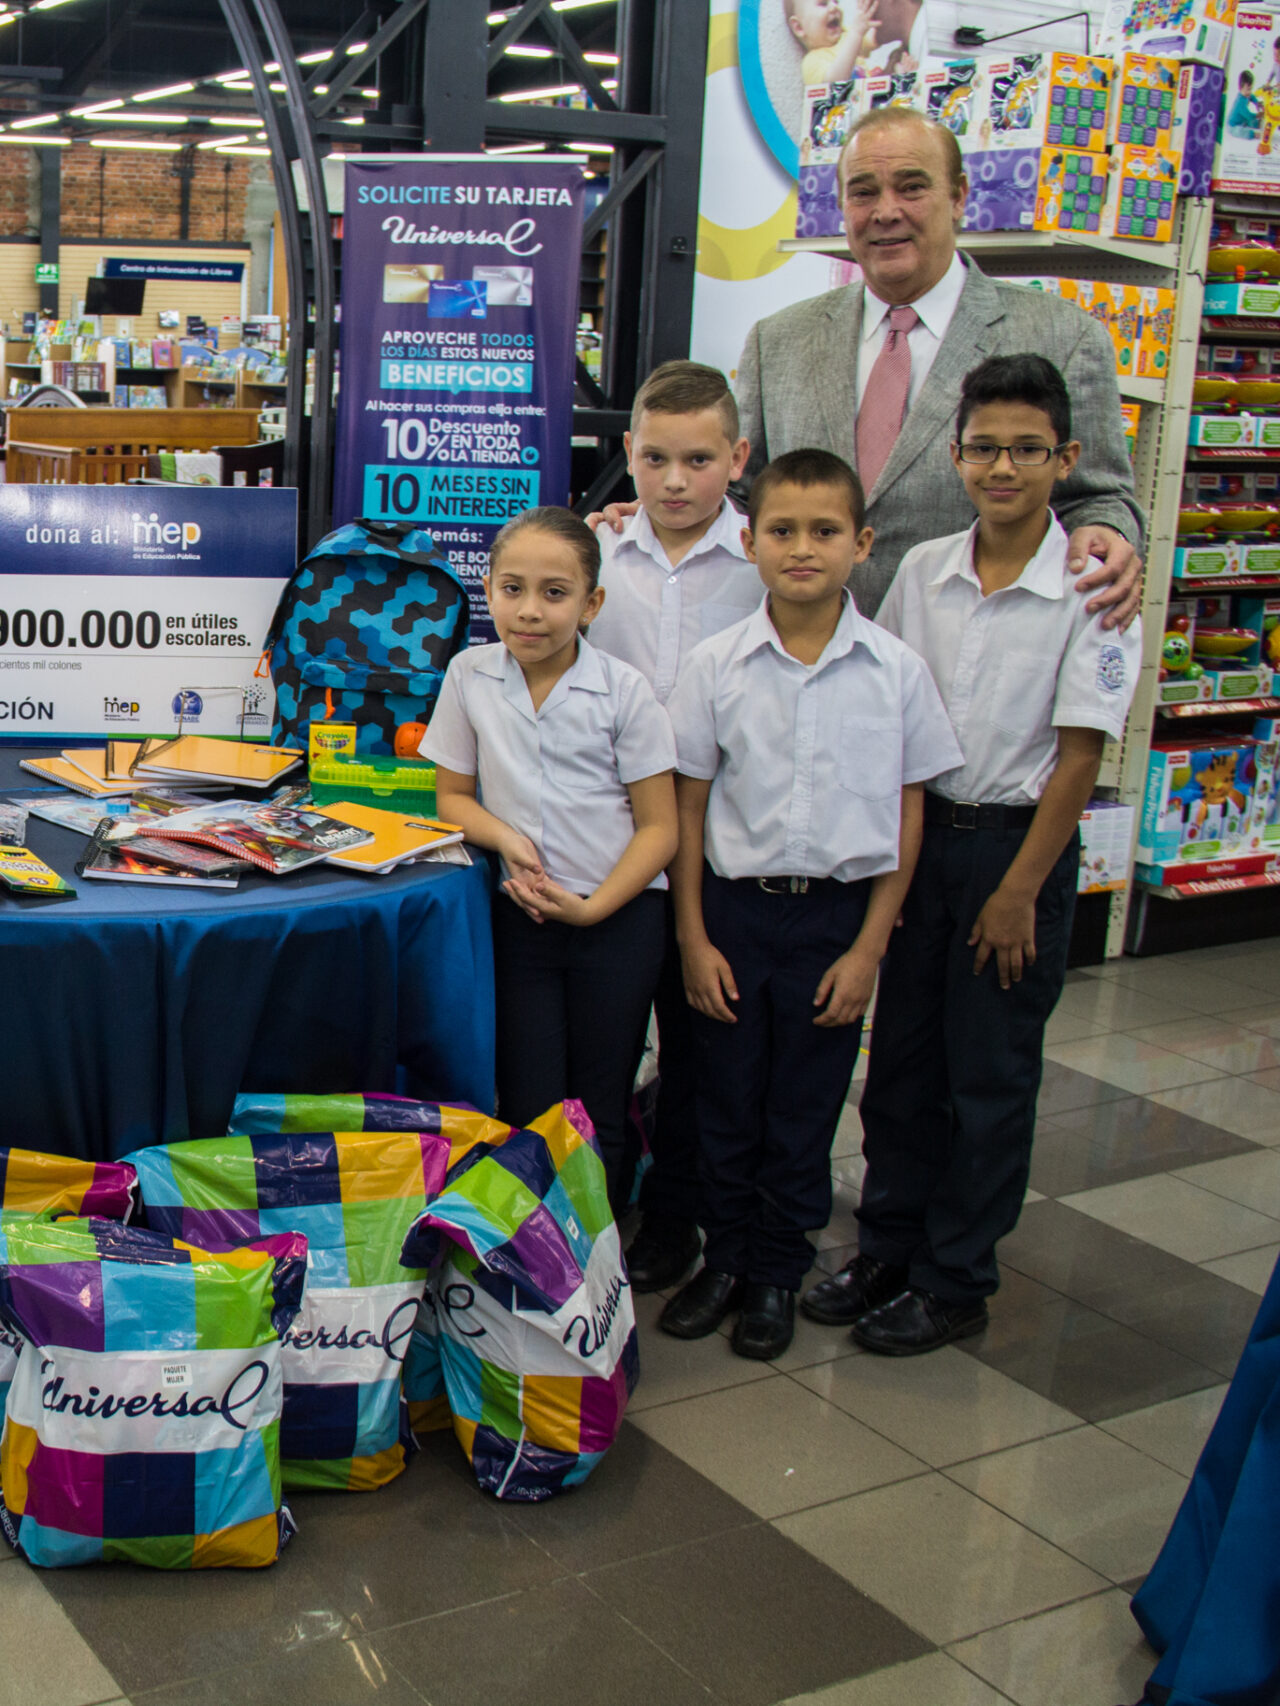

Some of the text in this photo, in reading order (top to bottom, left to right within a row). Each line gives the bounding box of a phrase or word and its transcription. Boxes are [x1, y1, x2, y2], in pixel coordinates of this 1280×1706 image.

[358, 185, 573, 206] SOLICITE SU TARJETA
[381, 215, 543, 256] Universal
[381, 330, 534, 347] APROVECHE TODOS
[380, 342, 535, 361] LOS DÍAS ESTOS NUEVOS
[387, 363, 525, 387] BENEFICIOS
[365, 400, 547, 417] Al hacer sus compras elija entre:
[429, 418, 521, 436] Descuento
[451, 435, 520, 450] EN TODA
[451, 450, 521, 464] LA TIENDA
[430, 474, 531, 495] MESES SIN
[374, 472, 420, 515] 10
[428, 496, 529, 518] INTERESES
[26, 523, 81, 544] dona
[91, 524, 119, 544] al:
[132, 512, 201, 551] mep
[425, 527, 484, 544] demás:
[448, 550, 465, 563] DE
[166, 612, 238, 629] en útiles
[165, 631, 251, 647] escolares.
[32, 659, 46, 670] mil
[48, 660, 82, 670] colones
[104, 697, 140, 716] mep
[316, 731, 349, 741] Crayola
[281, 1297, 420, 1362] versal
[163, 1364, 187, 1374] PAQUETE
[166, 1374, 184, 1384] MUJER
